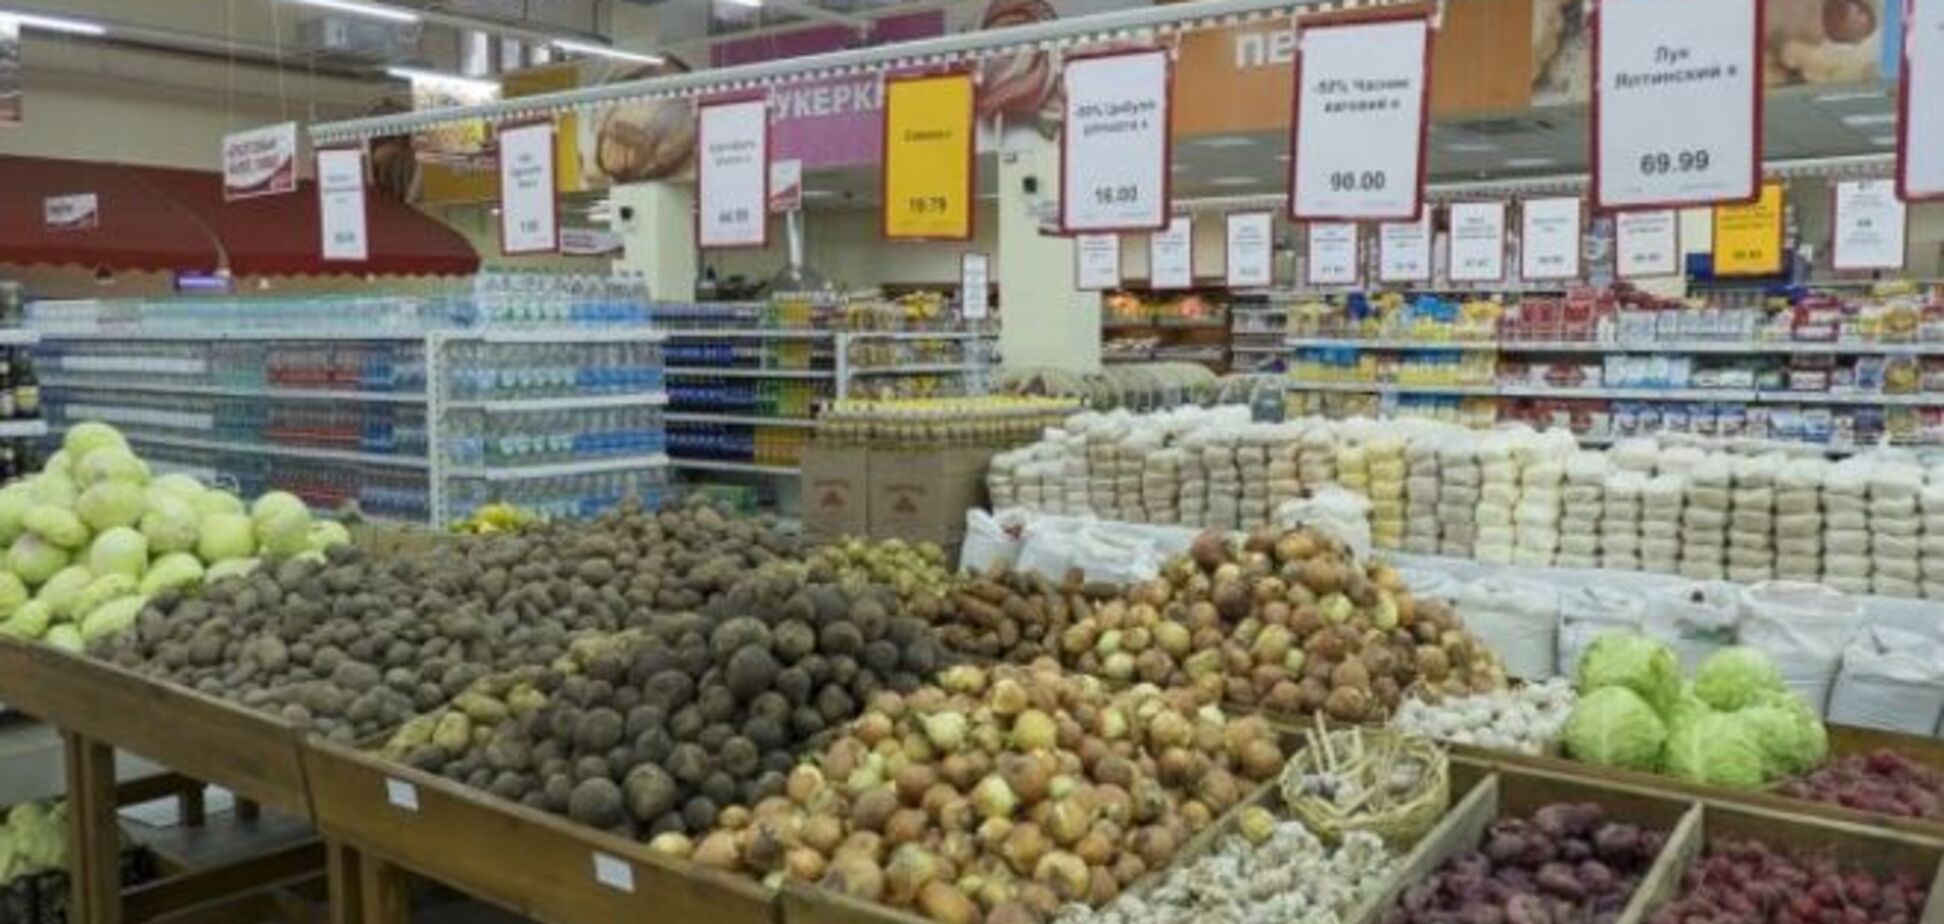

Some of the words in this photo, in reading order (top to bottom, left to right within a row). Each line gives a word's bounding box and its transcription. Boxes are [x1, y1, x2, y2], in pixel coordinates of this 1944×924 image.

[1654, 46, 1690, 64] Лук
[1614, 66, 1721, 88] Ялтинский
[1639, 149, 1710, 175] 69.99
[1329, 170, 1386, 193] 90.00
